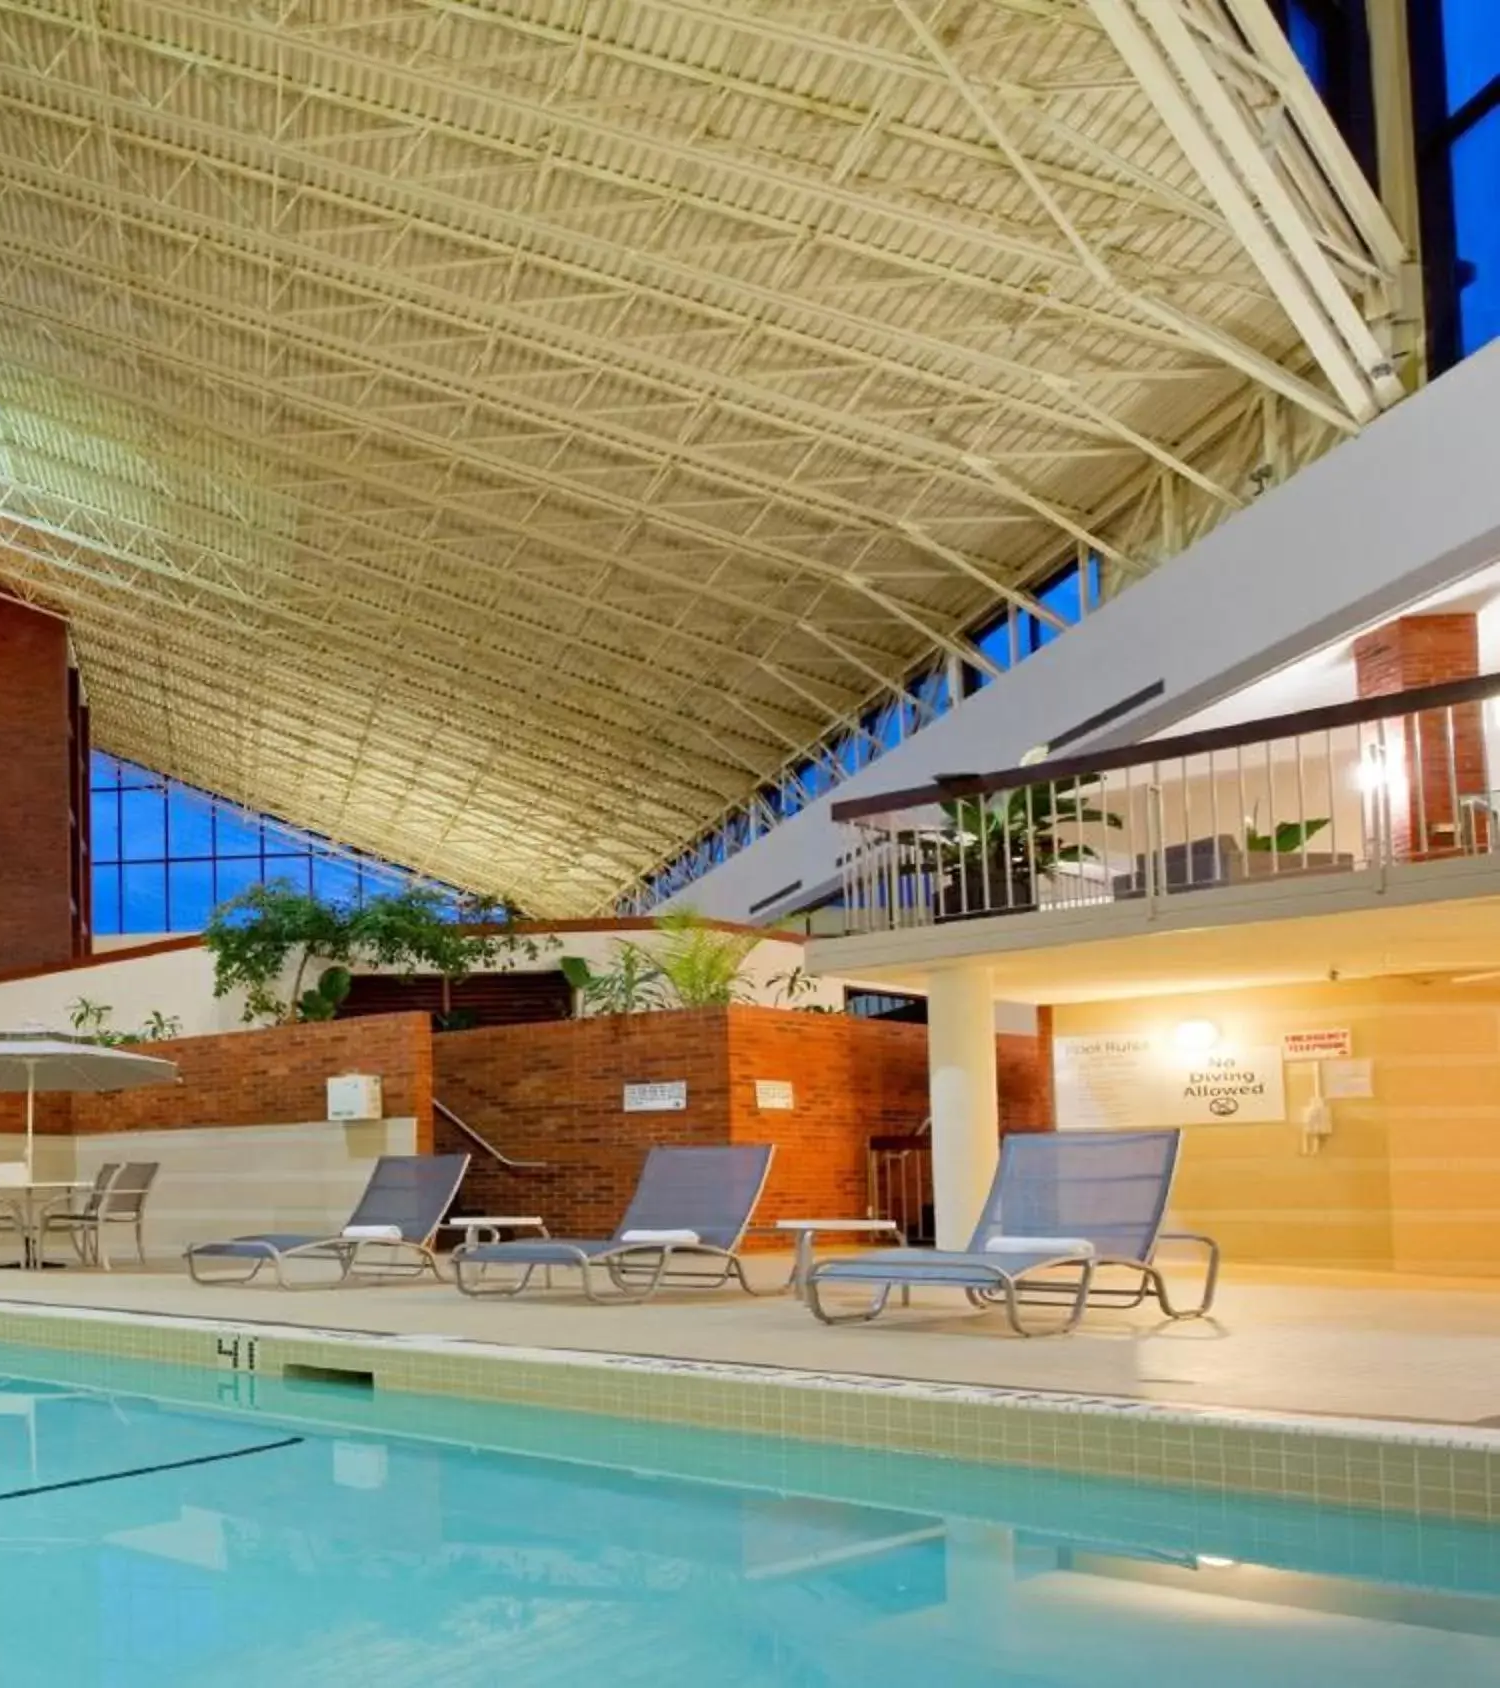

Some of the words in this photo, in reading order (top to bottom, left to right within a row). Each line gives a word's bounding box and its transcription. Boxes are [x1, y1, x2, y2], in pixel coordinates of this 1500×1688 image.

[1208, 1056, 1236, 1068] No
[1189, 1070, 1255, 1084] Diving
[1184, 1082, 1265, 1097] Allowed
